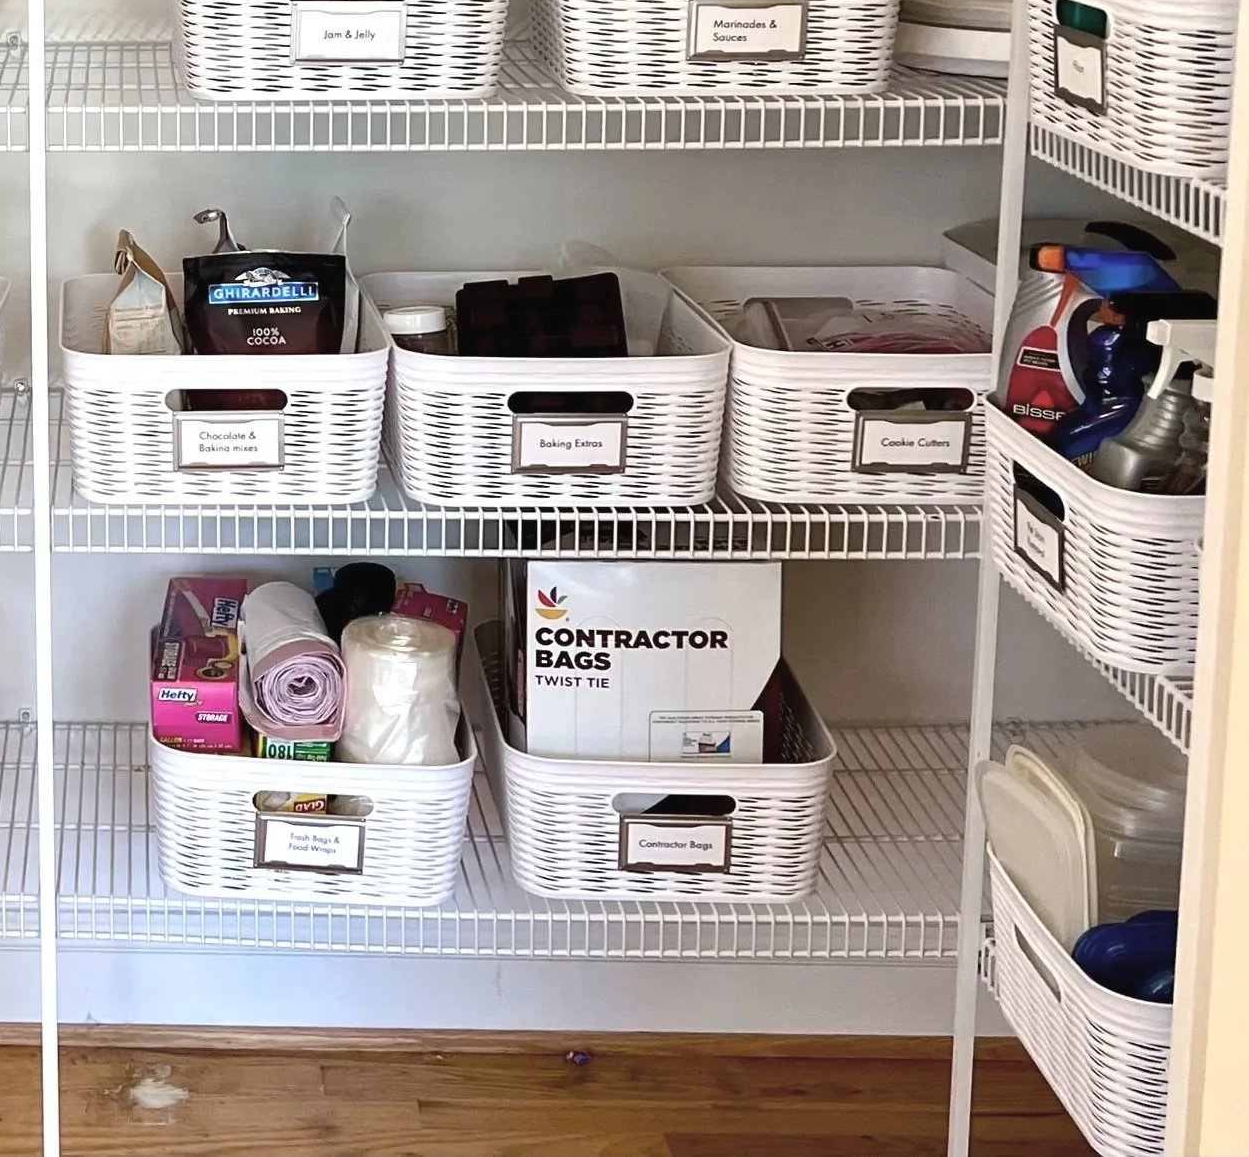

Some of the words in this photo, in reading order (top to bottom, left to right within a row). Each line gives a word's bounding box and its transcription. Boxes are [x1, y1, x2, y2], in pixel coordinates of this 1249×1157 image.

[713, 20, 766, 29] Marinades
[768, 20, 777, 29] &
[323, 30, 342, 40] Jam
[345, 30, 352, 39] &
[354, 30, 376, 40] Jelly
[712, 33, 748, 43] Sauces
[213, 286, 315, 300] GHIRARDELLI
[227, 307, 267, 316] PREMIUM
[269, 306, 302, 315] BAKING
[252, 327, 280, 337] 100%
[246, 335, 287, 346] COCOA
[199, 431, 246, 440] Chocolate
[248, 431, 256, 440] &
[232, 444, 259, 453] mixes
[539, 439, 573, 450] Baking
[574, 438, 604, 448] Extras
[880, 437, 915, 447] Cookie
[917, 437, 950, 448] Cutters
[212, 598, 238, 626] Hefty
[535, 627, 728, 649] CONTRACTOR
[535, 649, 612, 671] BAGS
[535, 675, 582, 688] TWIST
[586, 677, 610, 689] TIE
[161, 689, 194, 702] Hefty
[197, 713, 228, 722] STORAGE
[268, 744, 292, 760] 180
[295, 800, 325, 812] GLAD
[290, 832, 311, 842] Trash
[312, 835, 332, 845] Bags
[334, 836, 340, 844] &
[288, 842, 309, 852] Food
[311, 845, 337, 855] Wraps
[638, 839, 688, 849] Contractor
[689, 840, 713, 852] Bags
